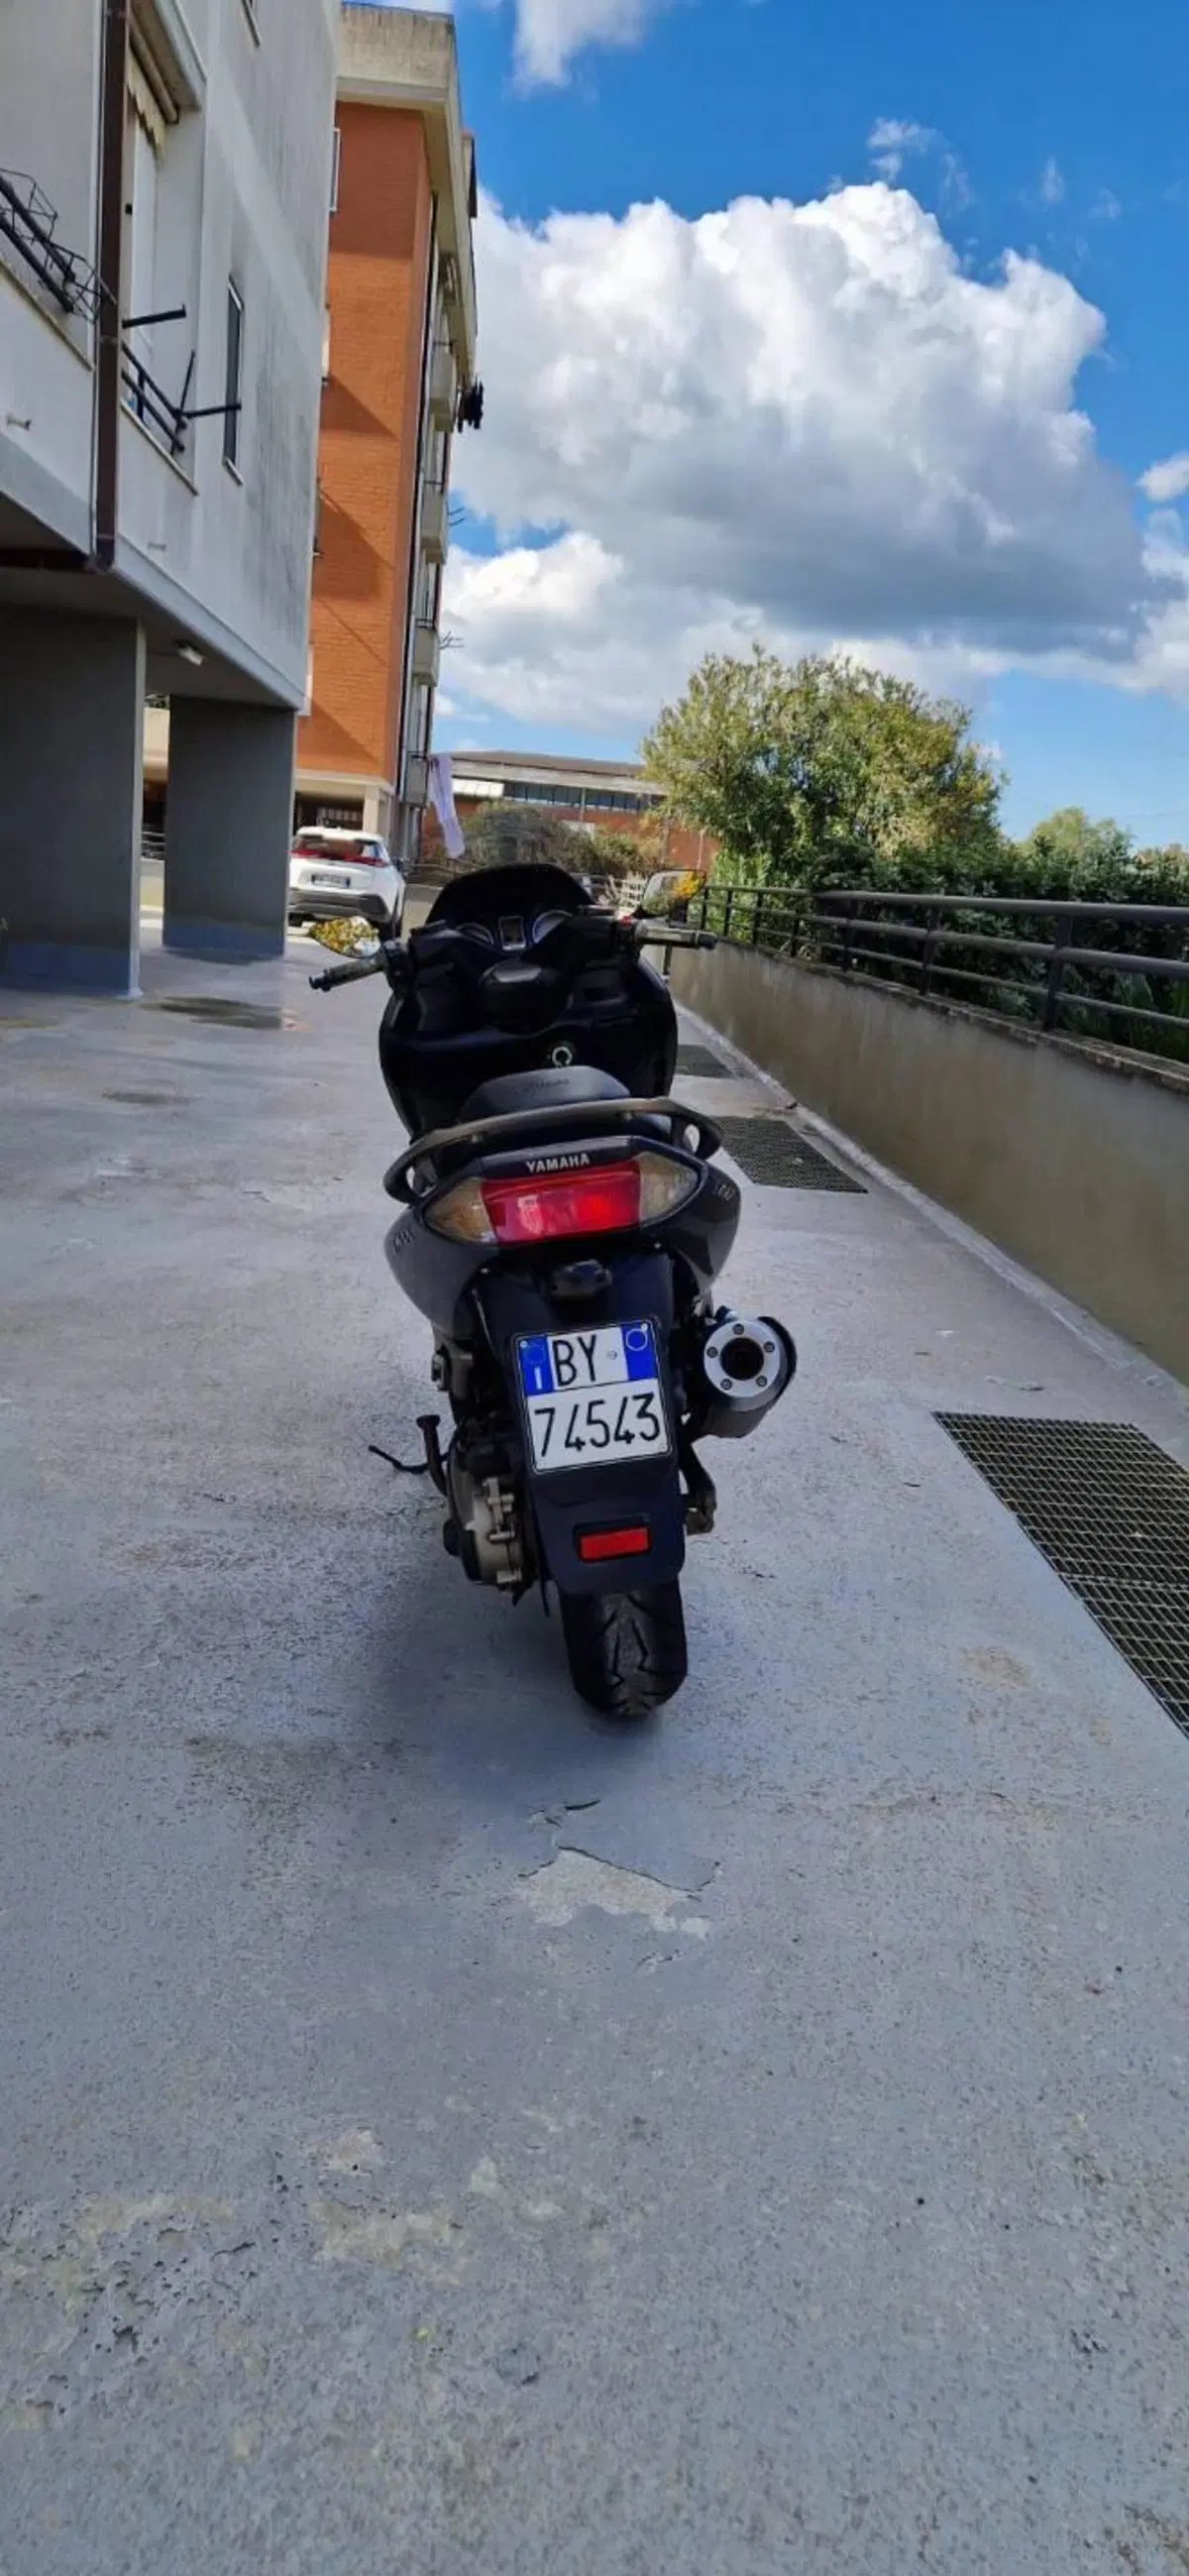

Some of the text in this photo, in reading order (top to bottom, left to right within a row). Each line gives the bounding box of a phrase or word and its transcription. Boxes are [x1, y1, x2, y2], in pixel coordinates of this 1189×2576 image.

[525, 1152, 592, 1174] YAMAHA
[552, 1334, 597, 1387] BY
[534, 1392, 661, 1457] 74543
